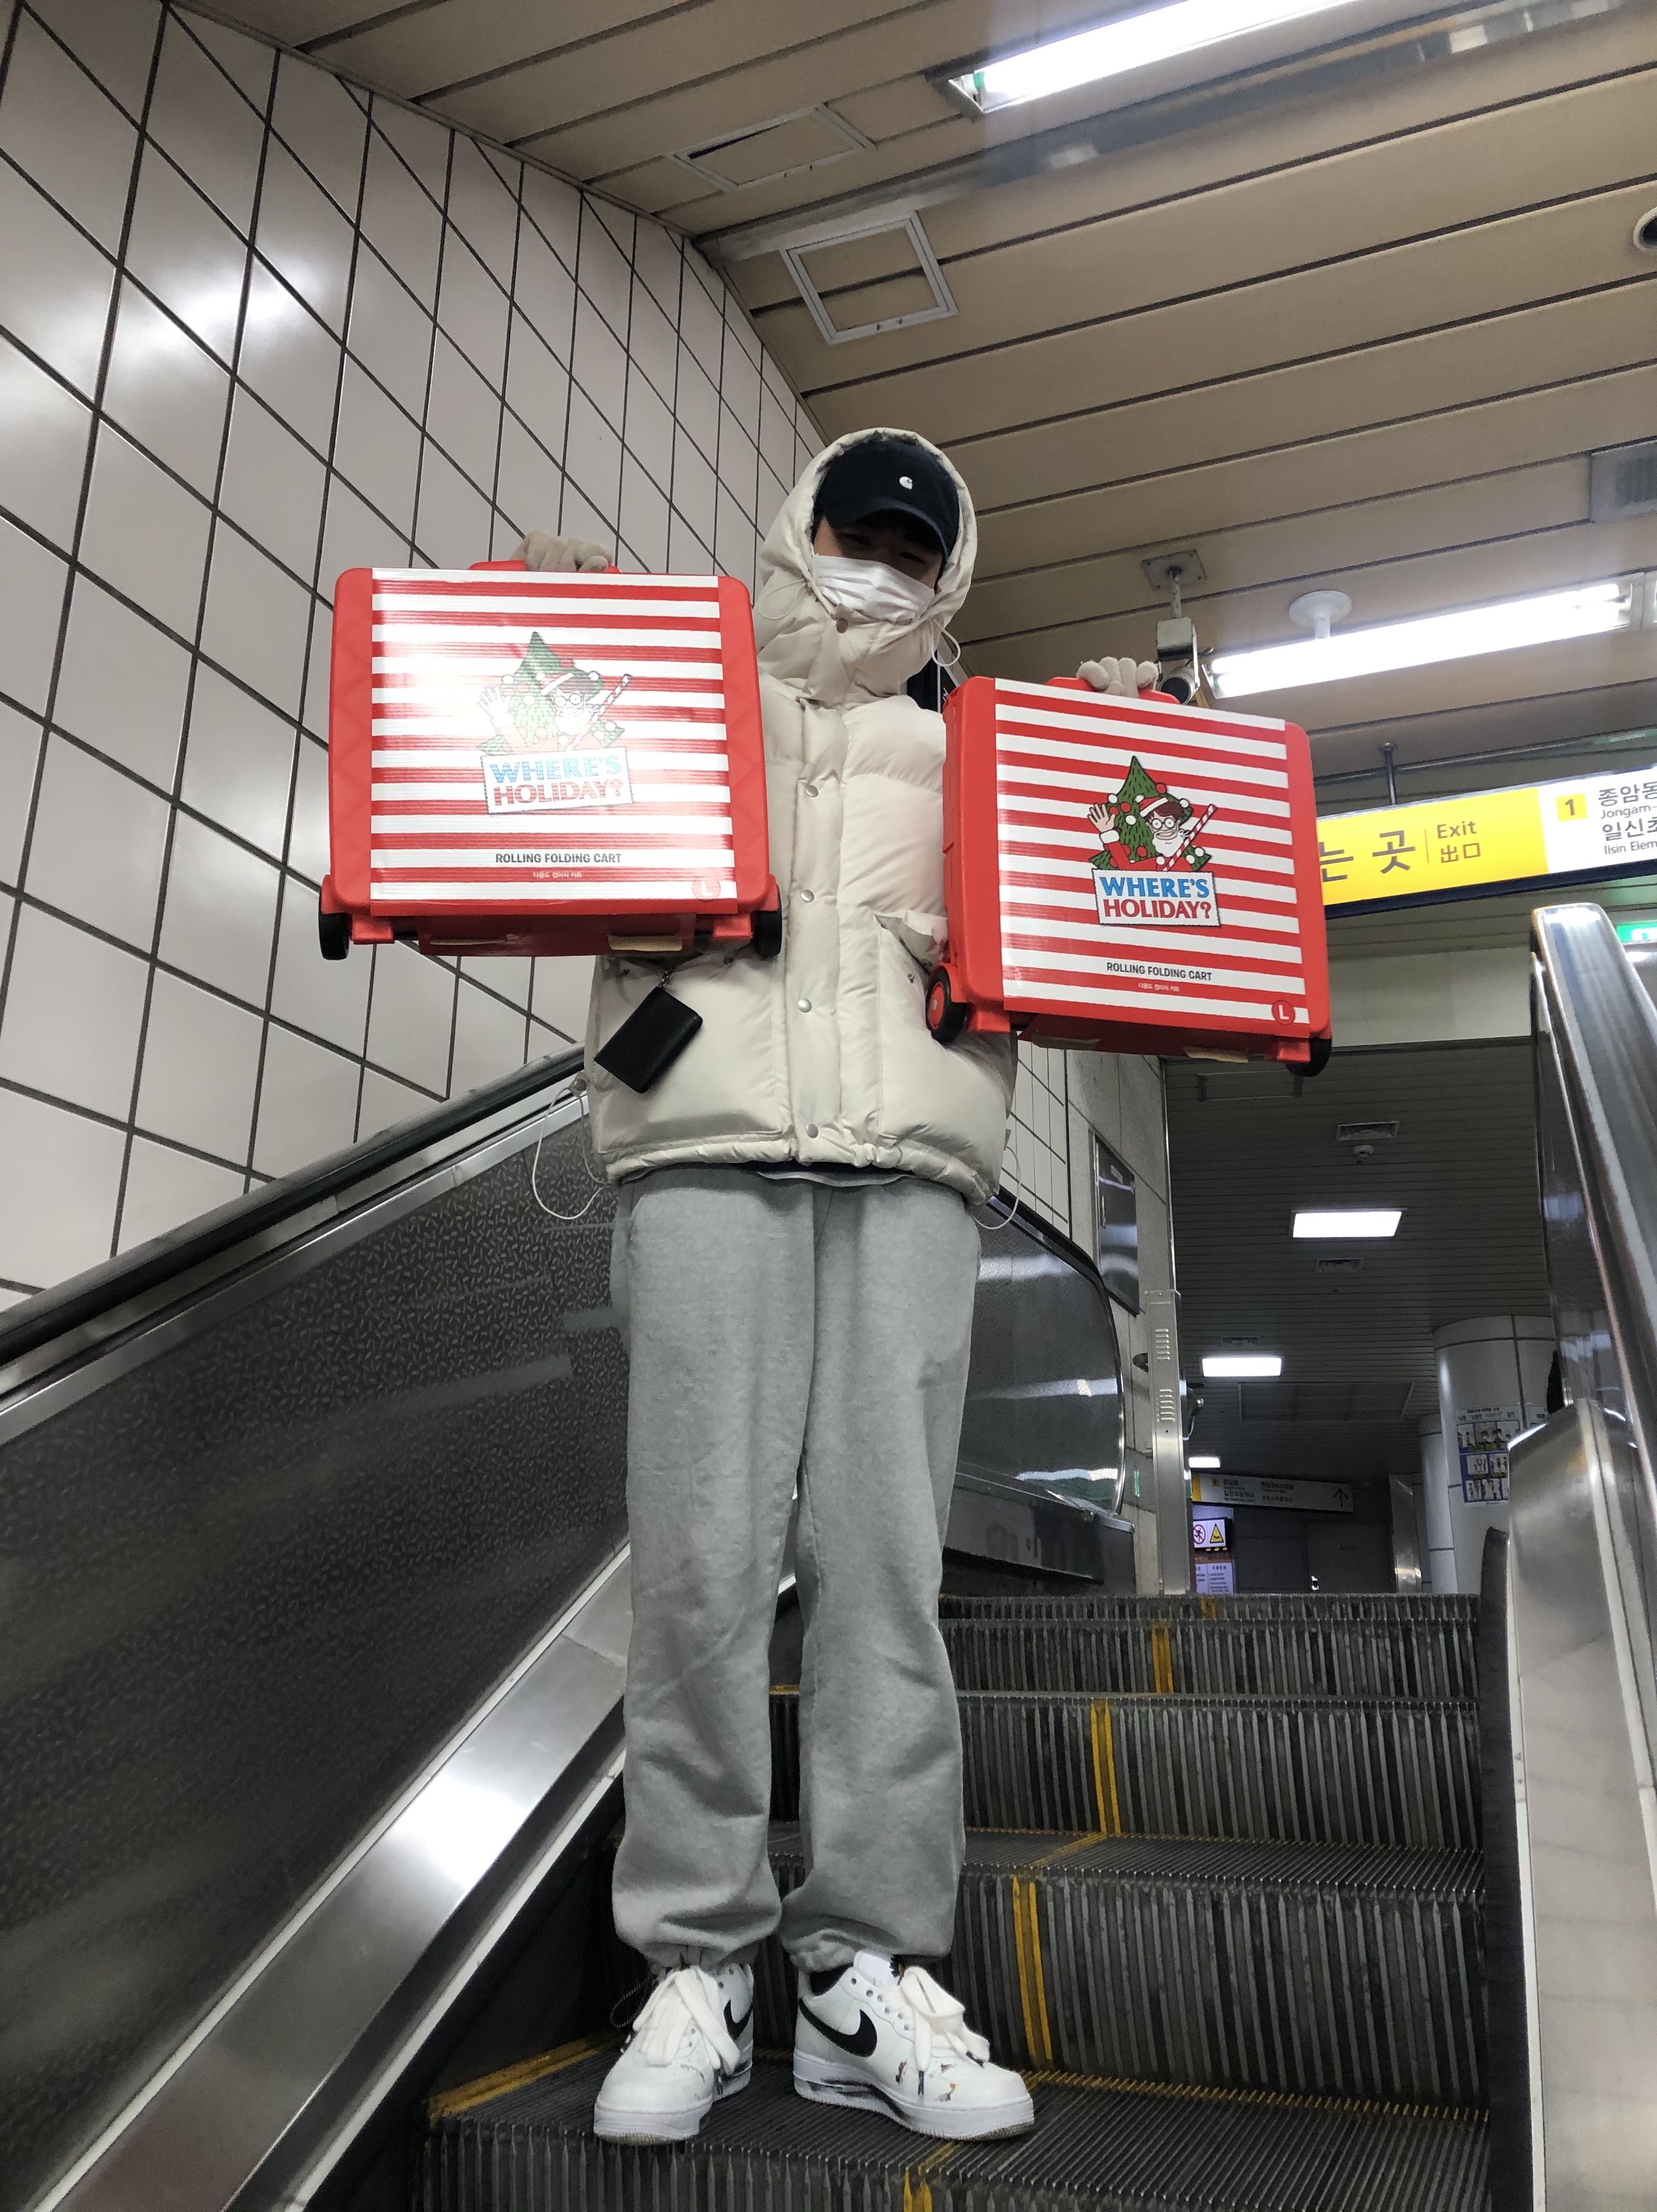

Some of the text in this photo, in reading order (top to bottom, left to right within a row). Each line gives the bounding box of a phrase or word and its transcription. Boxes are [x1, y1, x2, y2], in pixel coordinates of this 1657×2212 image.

[490, 755, 621, 783] WHERE'S
[494, 779, 623, 806] HOLIDAY?
[1598, 781, 1657, 806] 종암동
[1564, 799, 1575, 816] 1
[1437, 820, 1477, 839] Exit
[495, 853, 622, 863] ROLLING FOLDING CART
[1372, 830, 1416, 874] 곳
[1440, 842, 1481, 863] 出口
[1604, 843, 1626, 855] Ilsin
[1099, 877, 1209, 898] WHERE'S
[1103, 899, 1212, 919] HOLIDAY?
[1106, 962, 1212, 981] ROLLING FOLDING CART
[1279, 1005, 1290, 1020] L
